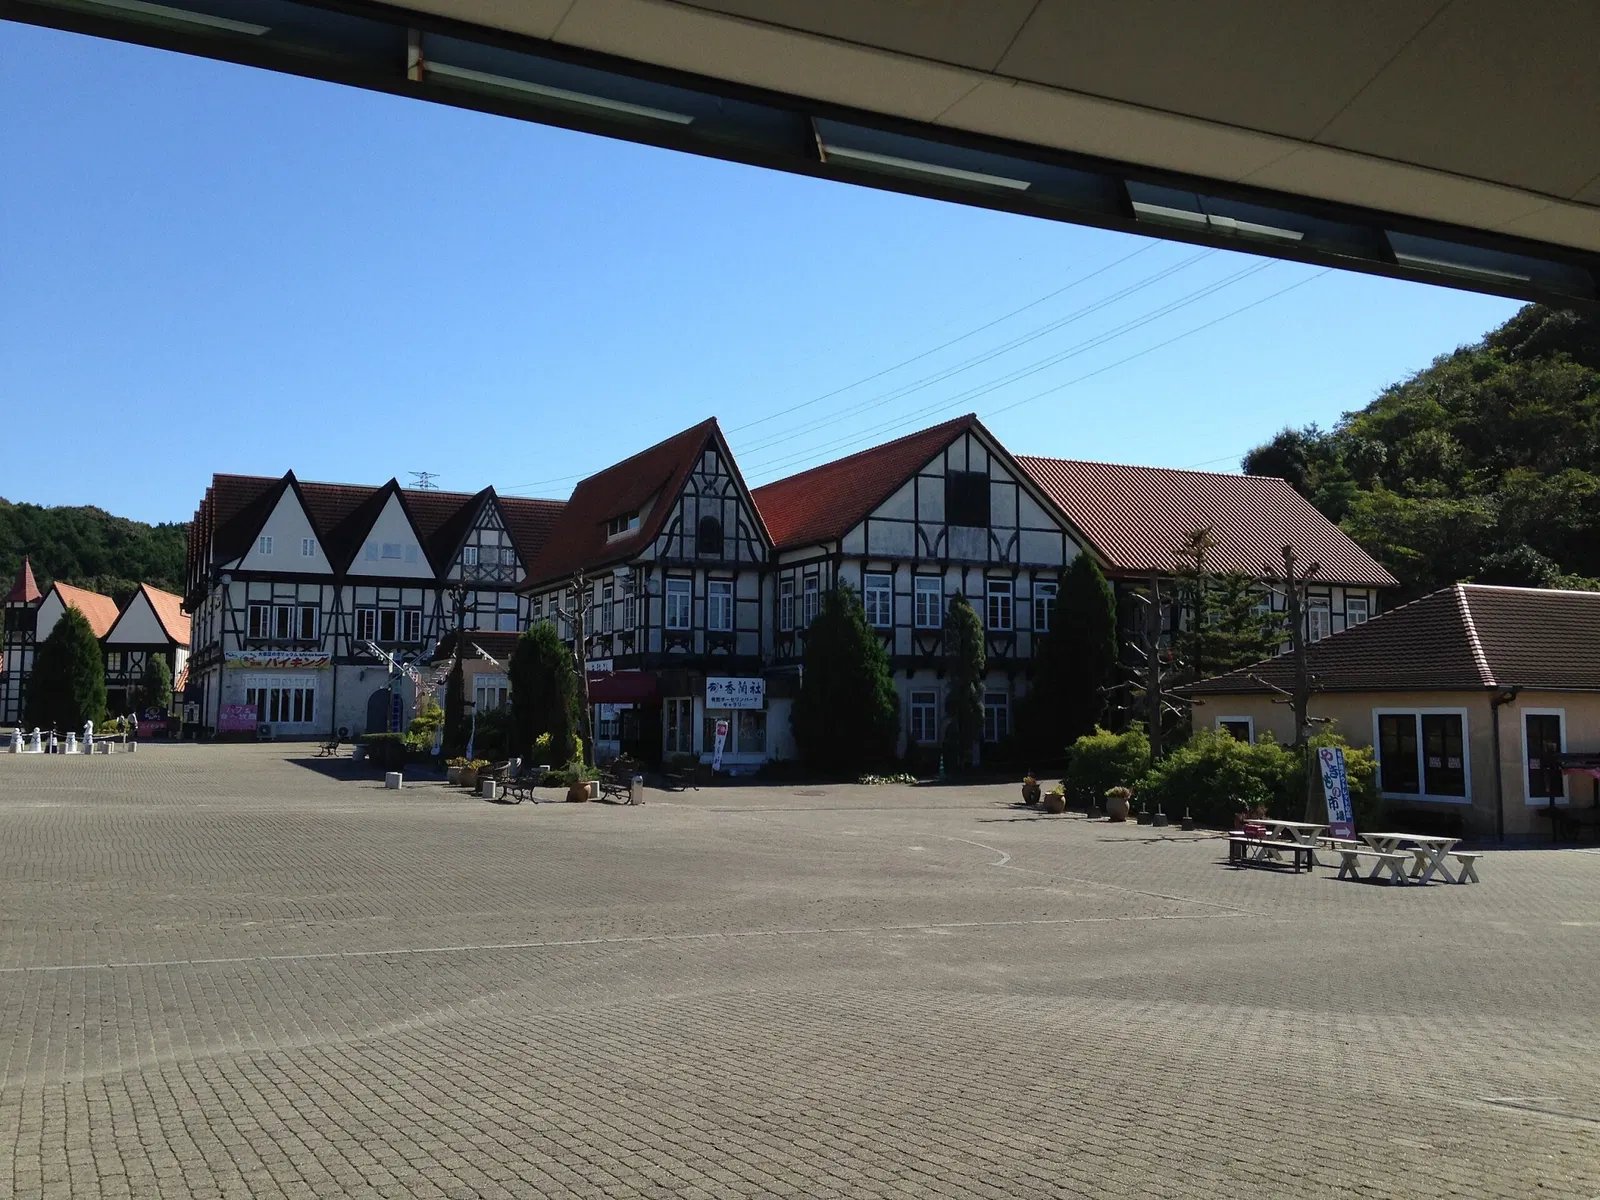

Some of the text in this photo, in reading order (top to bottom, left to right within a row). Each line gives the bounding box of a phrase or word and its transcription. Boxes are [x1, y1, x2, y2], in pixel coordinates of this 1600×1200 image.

[264, 656, 330, 667] バイキング
[1320, 749, 1345, 821] やきもの市場
